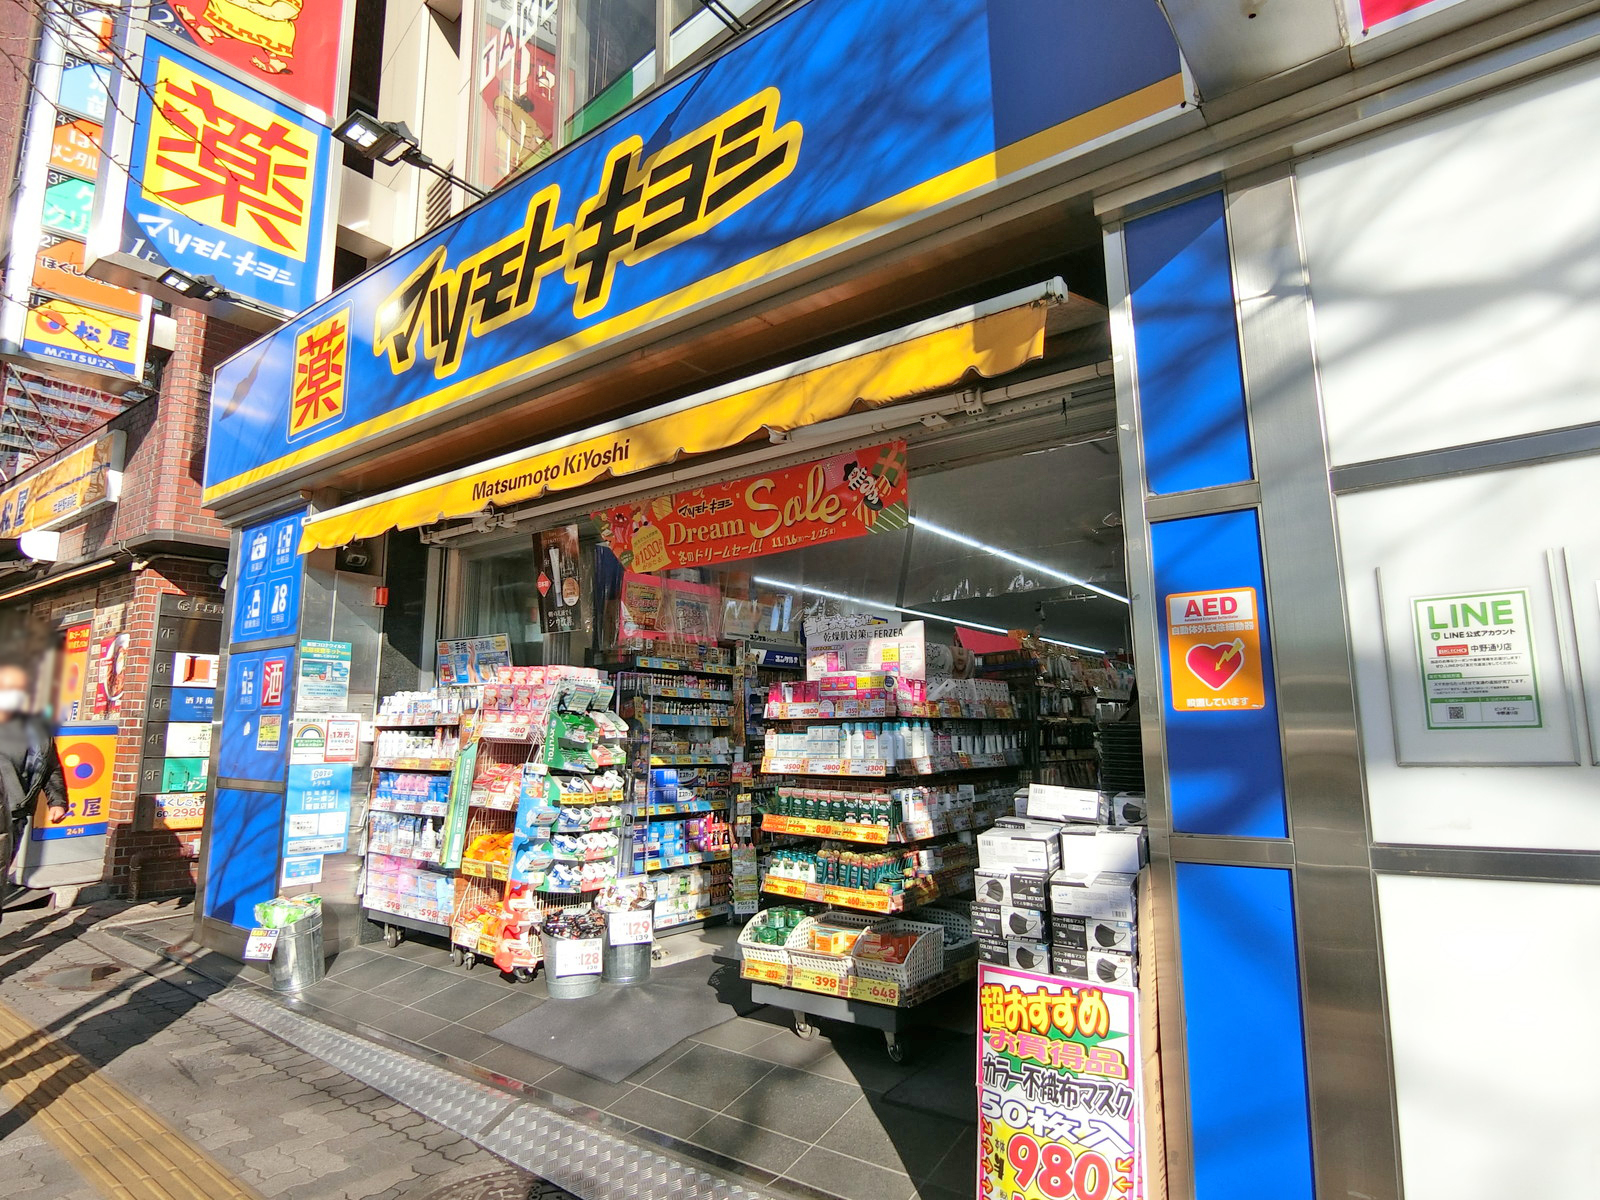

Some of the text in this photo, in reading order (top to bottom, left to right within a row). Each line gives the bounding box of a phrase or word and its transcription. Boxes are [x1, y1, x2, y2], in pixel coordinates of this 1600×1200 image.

[150, 8, 185, 35] 2F
[157, 80, 309, 251] 薬
[40, 234, 62, 248] 2F
[377, 100, 797, 372] マツモトキヨシ
[127, 238, 159, 265] 1F
[138, 213, 296, 288] マツモトキヨシ
[74, 320, 131, 351] 松屋
[294, 320, 346, 429] 薬
[472, 438, 631, 501] Matsumoto KiYoshi
[667, 463, 848, 547] Dream Sale
[677, 497, 734, 518] マツモトキヨシ
[1184, 597, 1238, 618] AED
[1427, 600, 1514, 630] LINE
[873, 628, 904, 639] FERZEA
[1172, 621, 1255, 636] 自動体外式除細動器
[1443, 632, 1465, 640] LINE
[1466, 628, 1516, 638] 公式アカウント
[1471, 643, 1512, 653] 中野通り店
[156, 662, 172, 674] 6F
[263, 663, 284, 704] 酒
[153, 698, 168, 710] 5F
[148, 733, 164, 745] 4F
[547, 728, 556, 763] XYLITOL
[145, 769, 160, 781] 3F
[66, 828, 85, 836] 24H
[816, 825, 831, 835] 830
[866, 832, 878, 840] 830
[386, 900, 401, 910] 598
[421, 909, 438, 918] 598
[628, 920, 650, 935] 129
[257, 943, 273, 953] 299
[580, 952, 600, 966] 128
[815, 976, 837, 988] 398
[871, 987, 897, 999] 648
[980, 983, 1110, 1039] 超おすすめ
[987, 1027, 1128, 1079] お買得品
[981, 1053, 1135, 1119] カラー不織布マスク
[980, 1089, 1135, 1154] 50枚入
[1007, 1133, 1112, 1200] 980
